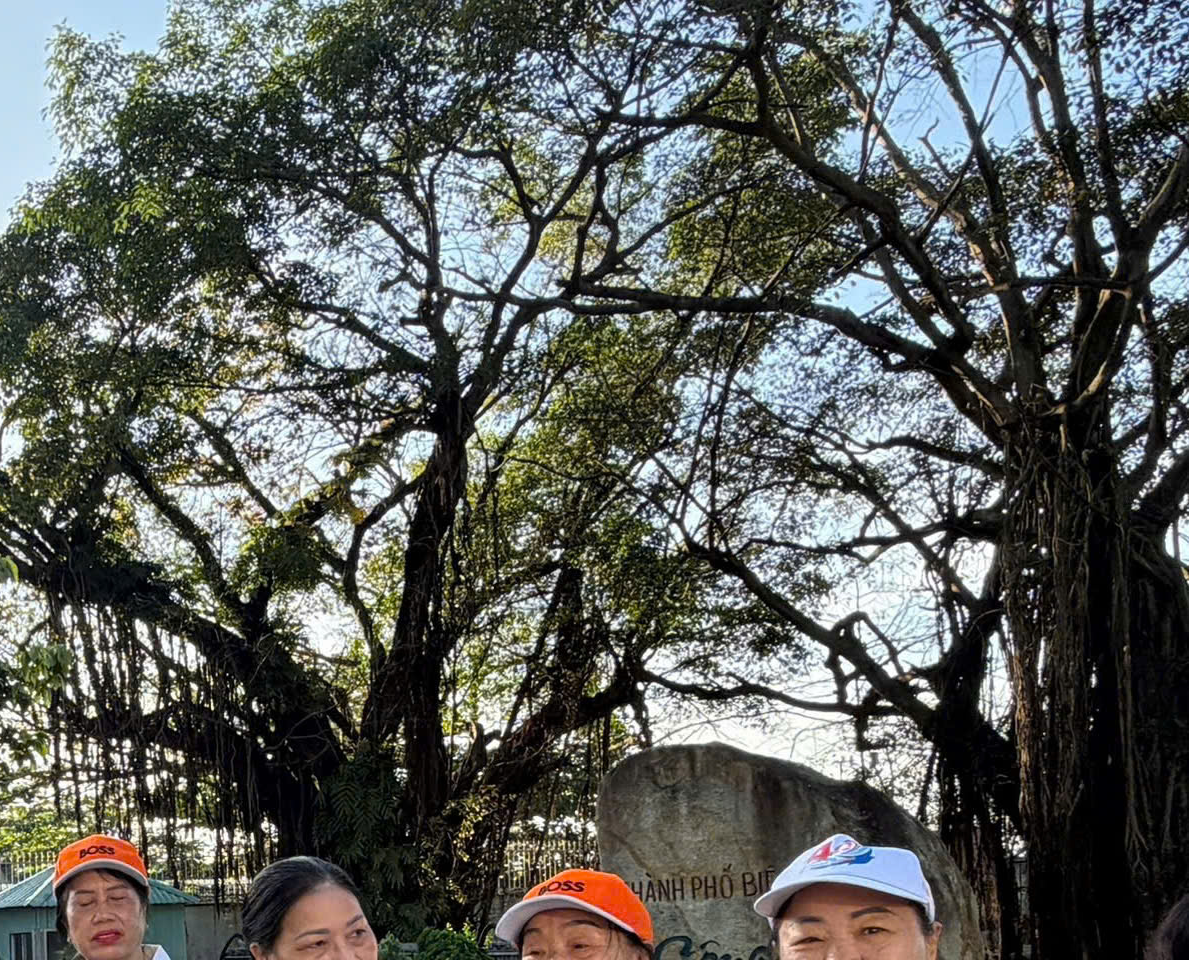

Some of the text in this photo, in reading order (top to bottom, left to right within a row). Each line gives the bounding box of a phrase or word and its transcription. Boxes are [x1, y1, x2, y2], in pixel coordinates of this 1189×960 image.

[79, 845, 116, 859] BOSS
[538, 879, 586, 897] BOSS
[625, 871, 685, 902] HÀNH
[690, 863, 734, 900] PHỐ
